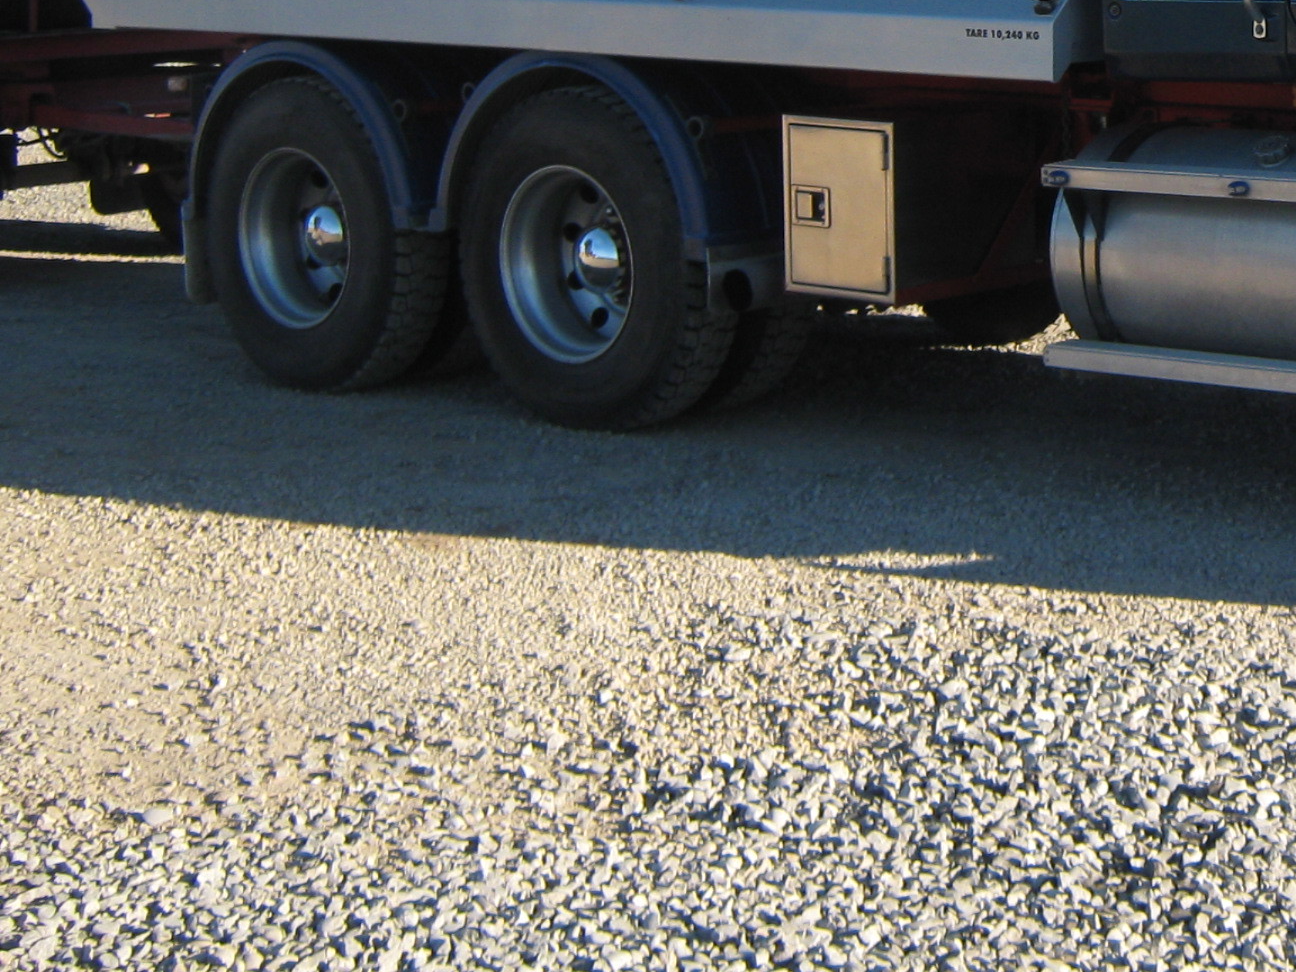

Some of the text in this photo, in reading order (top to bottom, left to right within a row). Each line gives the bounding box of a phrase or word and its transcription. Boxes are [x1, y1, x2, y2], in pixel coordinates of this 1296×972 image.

[966, 28, 1040, 40] TARE 10,240 KG
